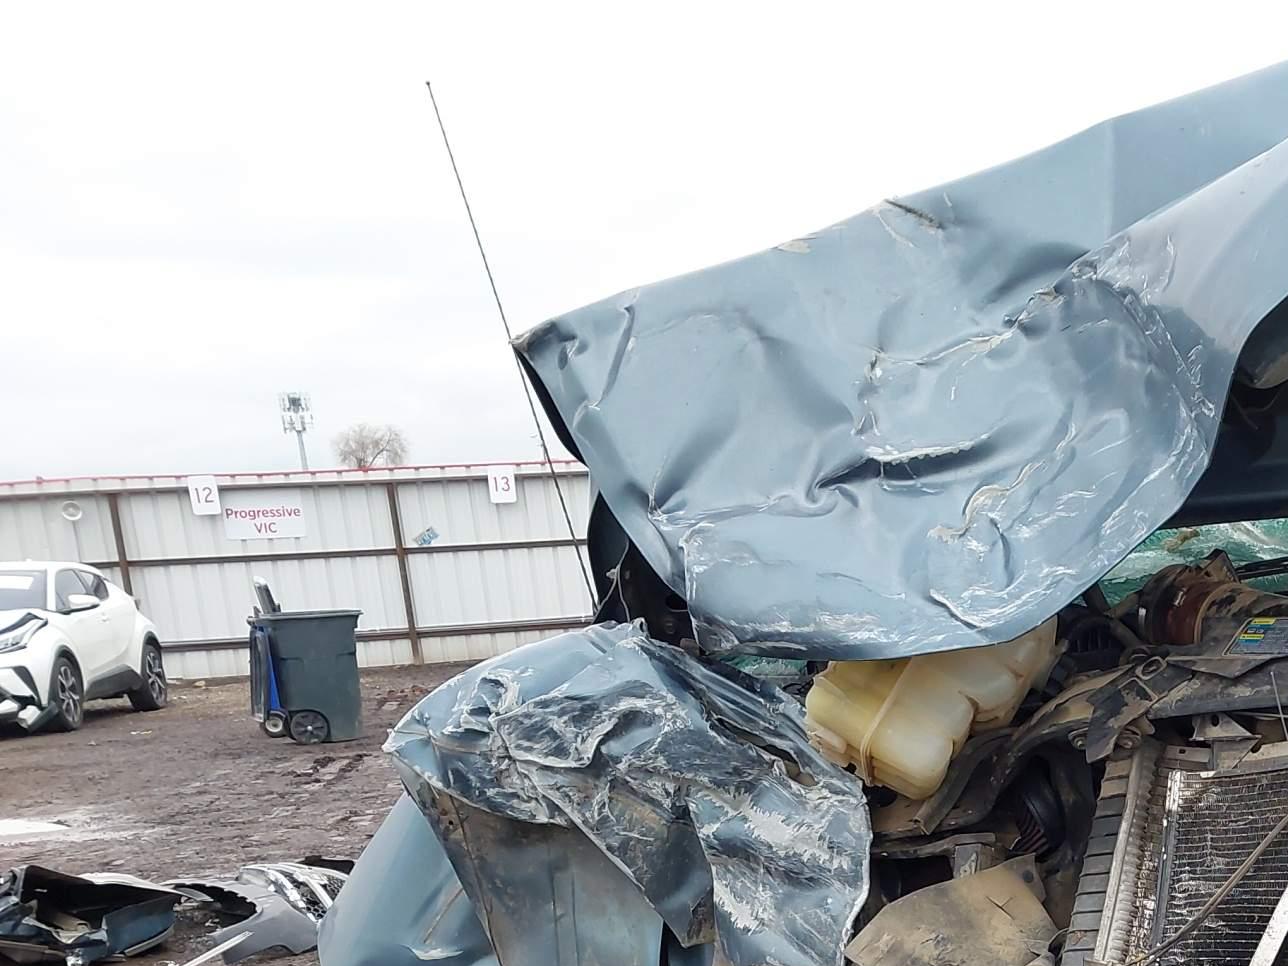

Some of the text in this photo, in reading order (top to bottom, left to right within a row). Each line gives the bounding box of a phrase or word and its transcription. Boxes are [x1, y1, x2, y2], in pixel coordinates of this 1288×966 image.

[494, 476, 510, 492] 13
[195, 487, 214, 504] 12
[225, 505, 301, 521] Progressive
[254, 522, 277, 534] VIC
